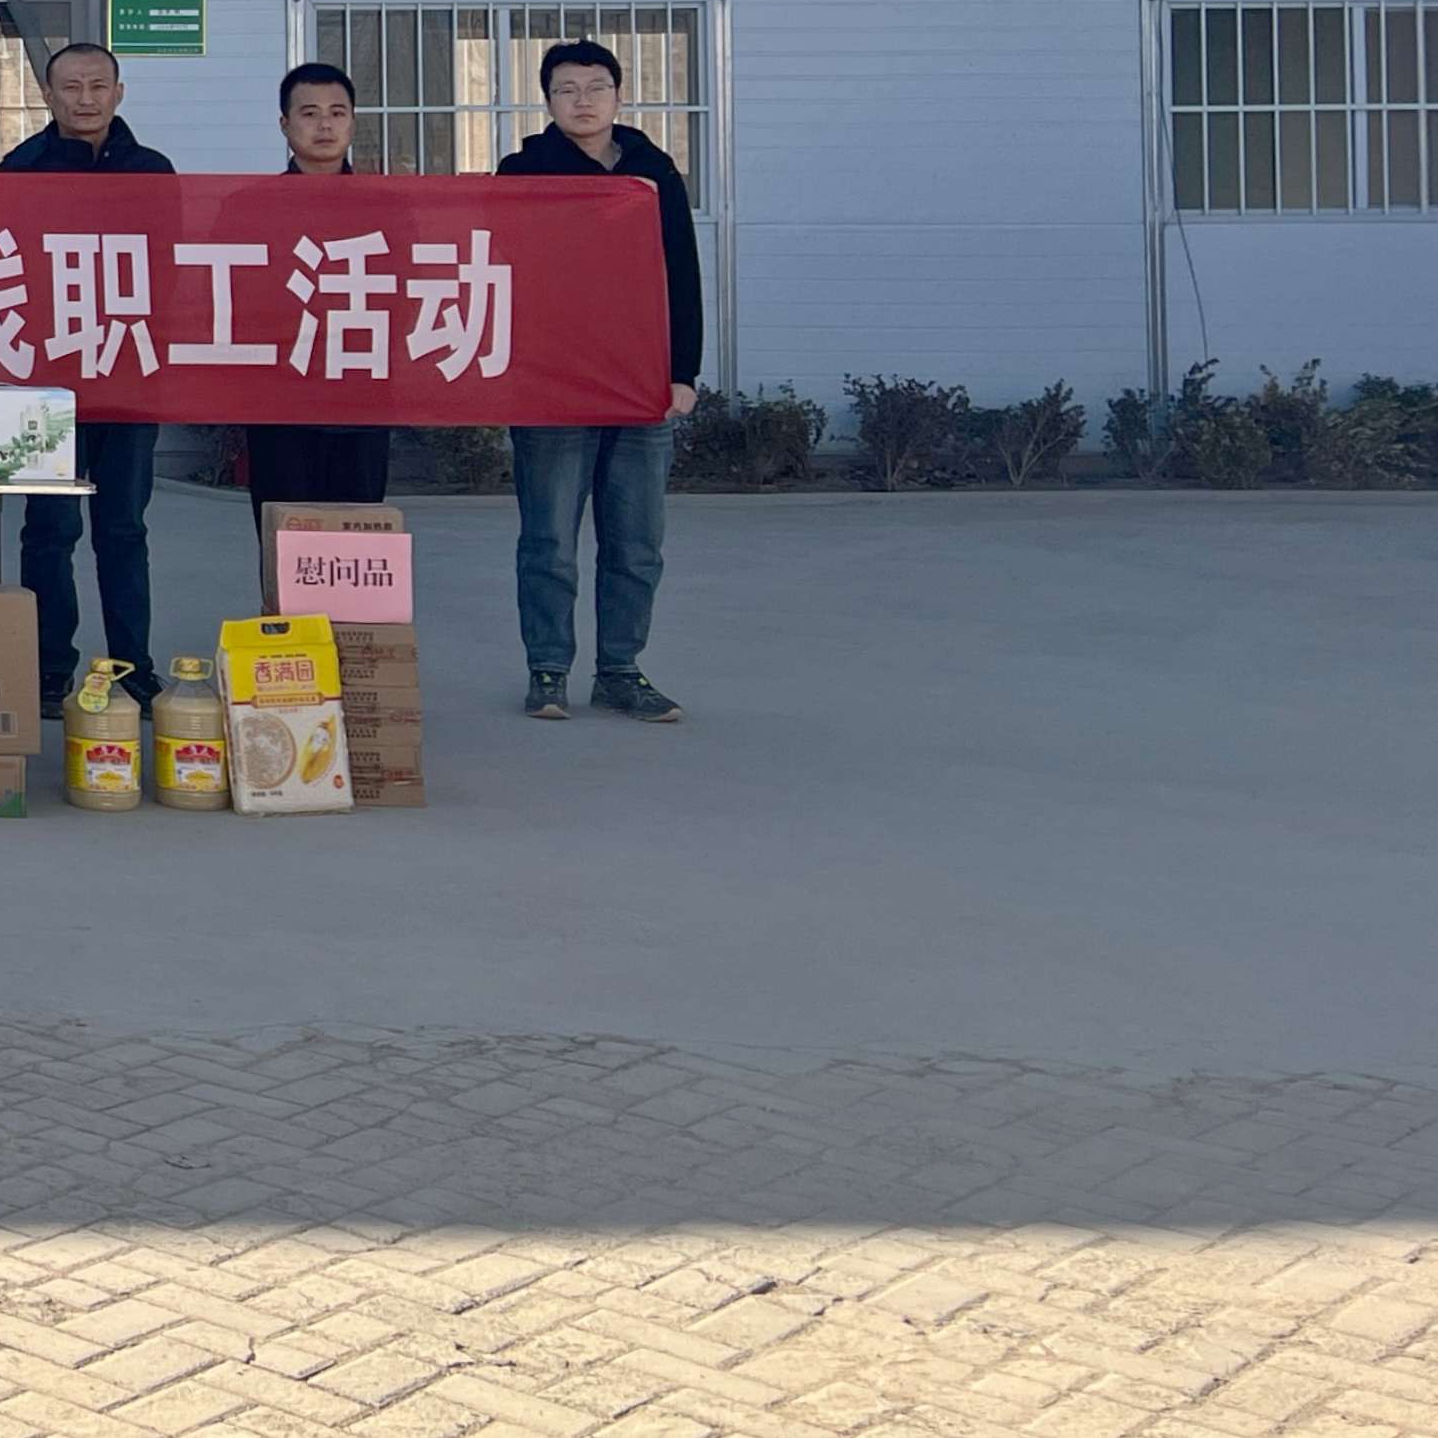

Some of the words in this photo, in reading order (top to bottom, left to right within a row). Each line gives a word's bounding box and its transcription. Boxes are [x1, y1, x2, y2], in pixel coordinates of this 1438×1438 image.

[295, 556, 393, 587] 慰问品
[255, 660, 314, 683] 香满园
